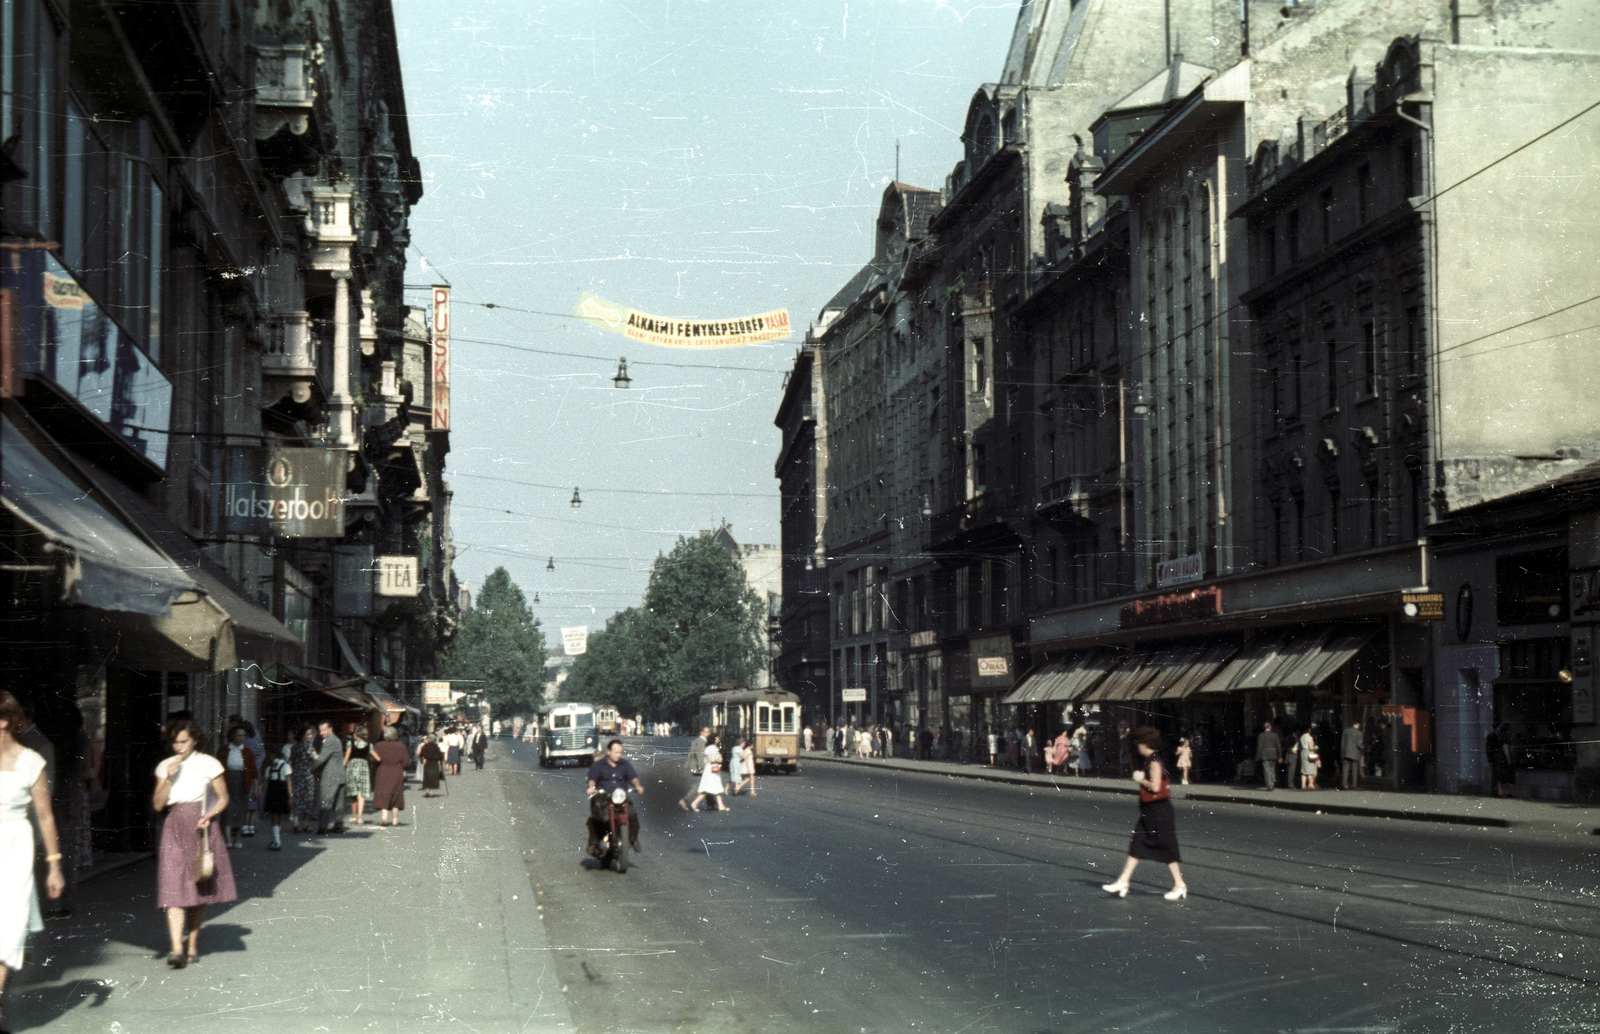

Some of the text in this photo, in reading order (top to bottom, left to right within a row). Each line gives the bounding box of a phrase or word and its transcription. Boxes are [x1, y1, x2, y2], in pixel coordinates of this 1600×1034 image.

[627, 312, 674, 336] ALKALMI
[434, 289, 448, 428] PUSKIN
[384, 563, 412, 588] TEA
